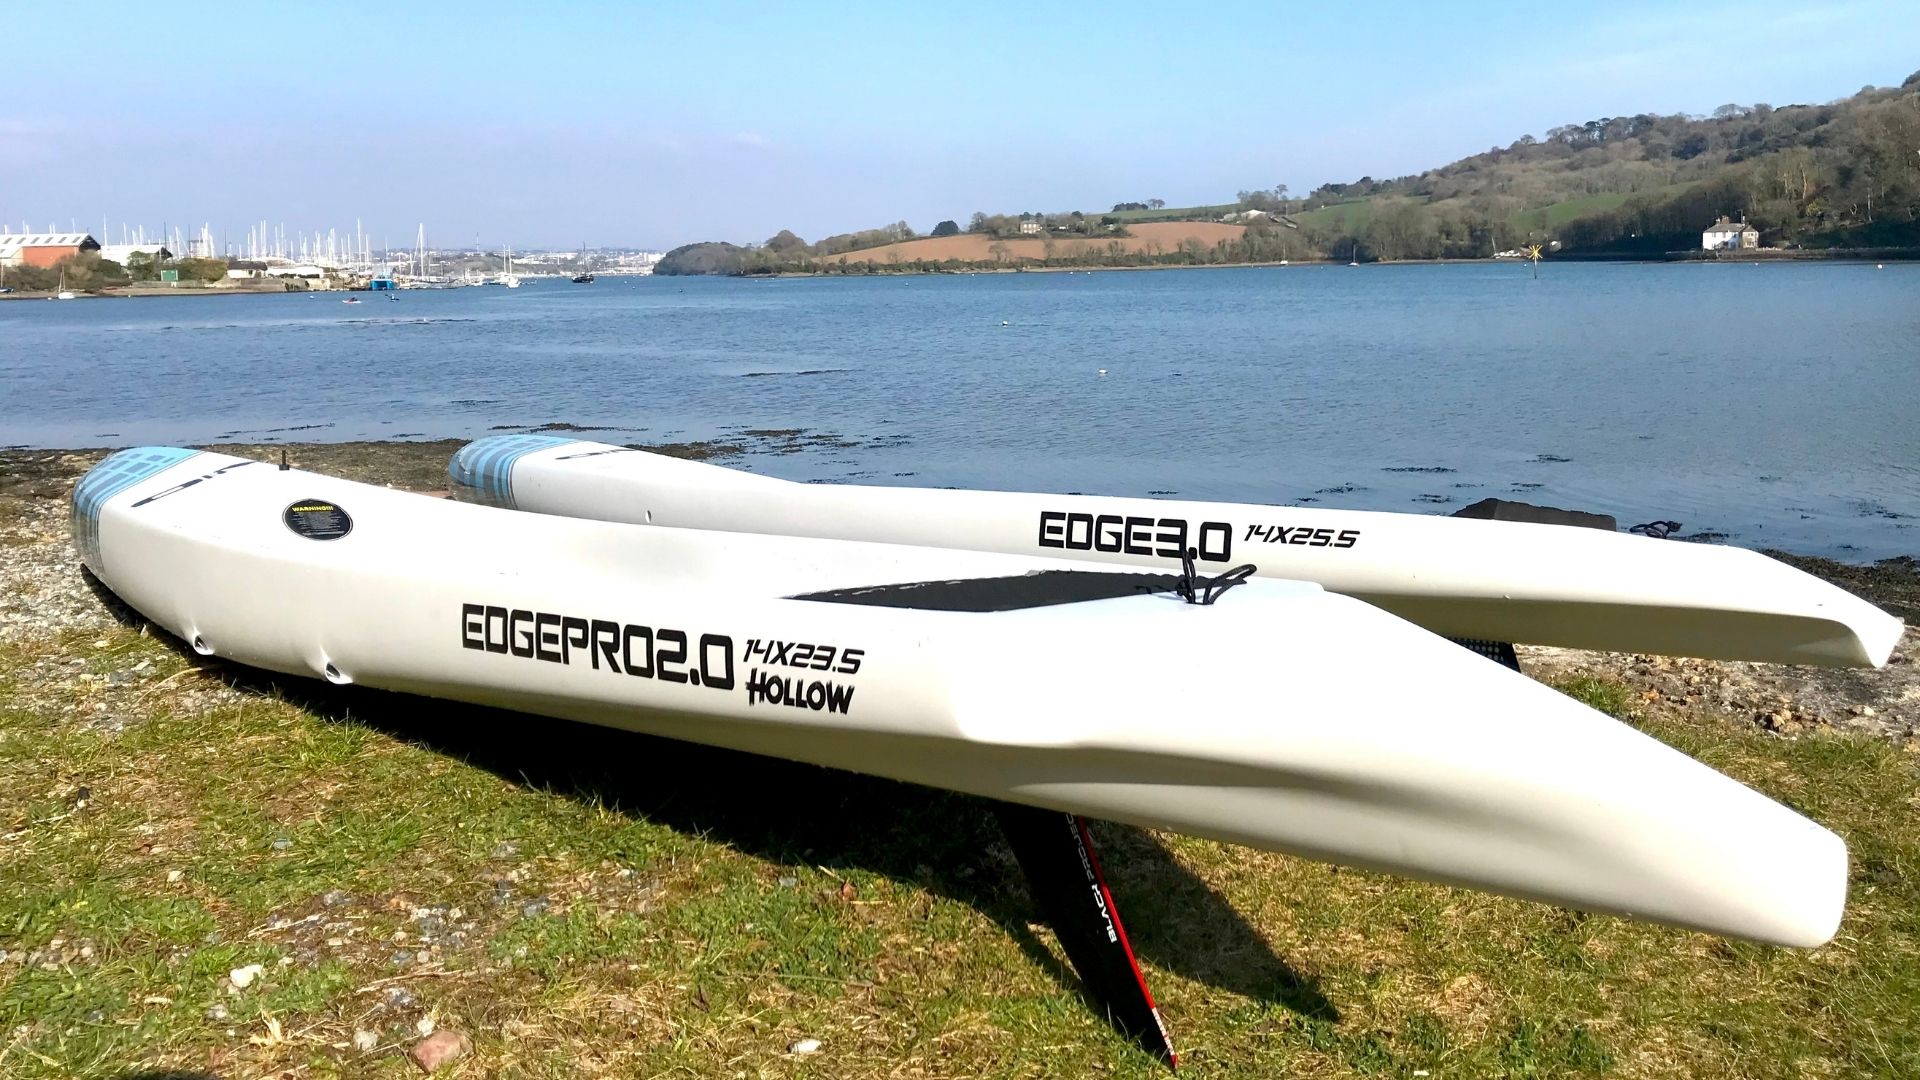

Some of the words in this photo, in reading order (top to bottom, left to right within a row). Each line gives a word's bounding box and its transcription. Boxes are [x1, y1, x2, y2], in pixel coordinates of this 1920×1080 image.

[1039, 511, 1233, 563] EDGE3.0
[1244, 524, 1361, 549] 14X25.5
[462, 603, 735, 691] EDGEPRO2.0
[743, 639, 866, 675] 14X23.5
[745, 667, 857, 715] HOLLOW
[1066, 812, 1095, 881] PROJEC
[1092, 883, 1118, 943] BLACK
